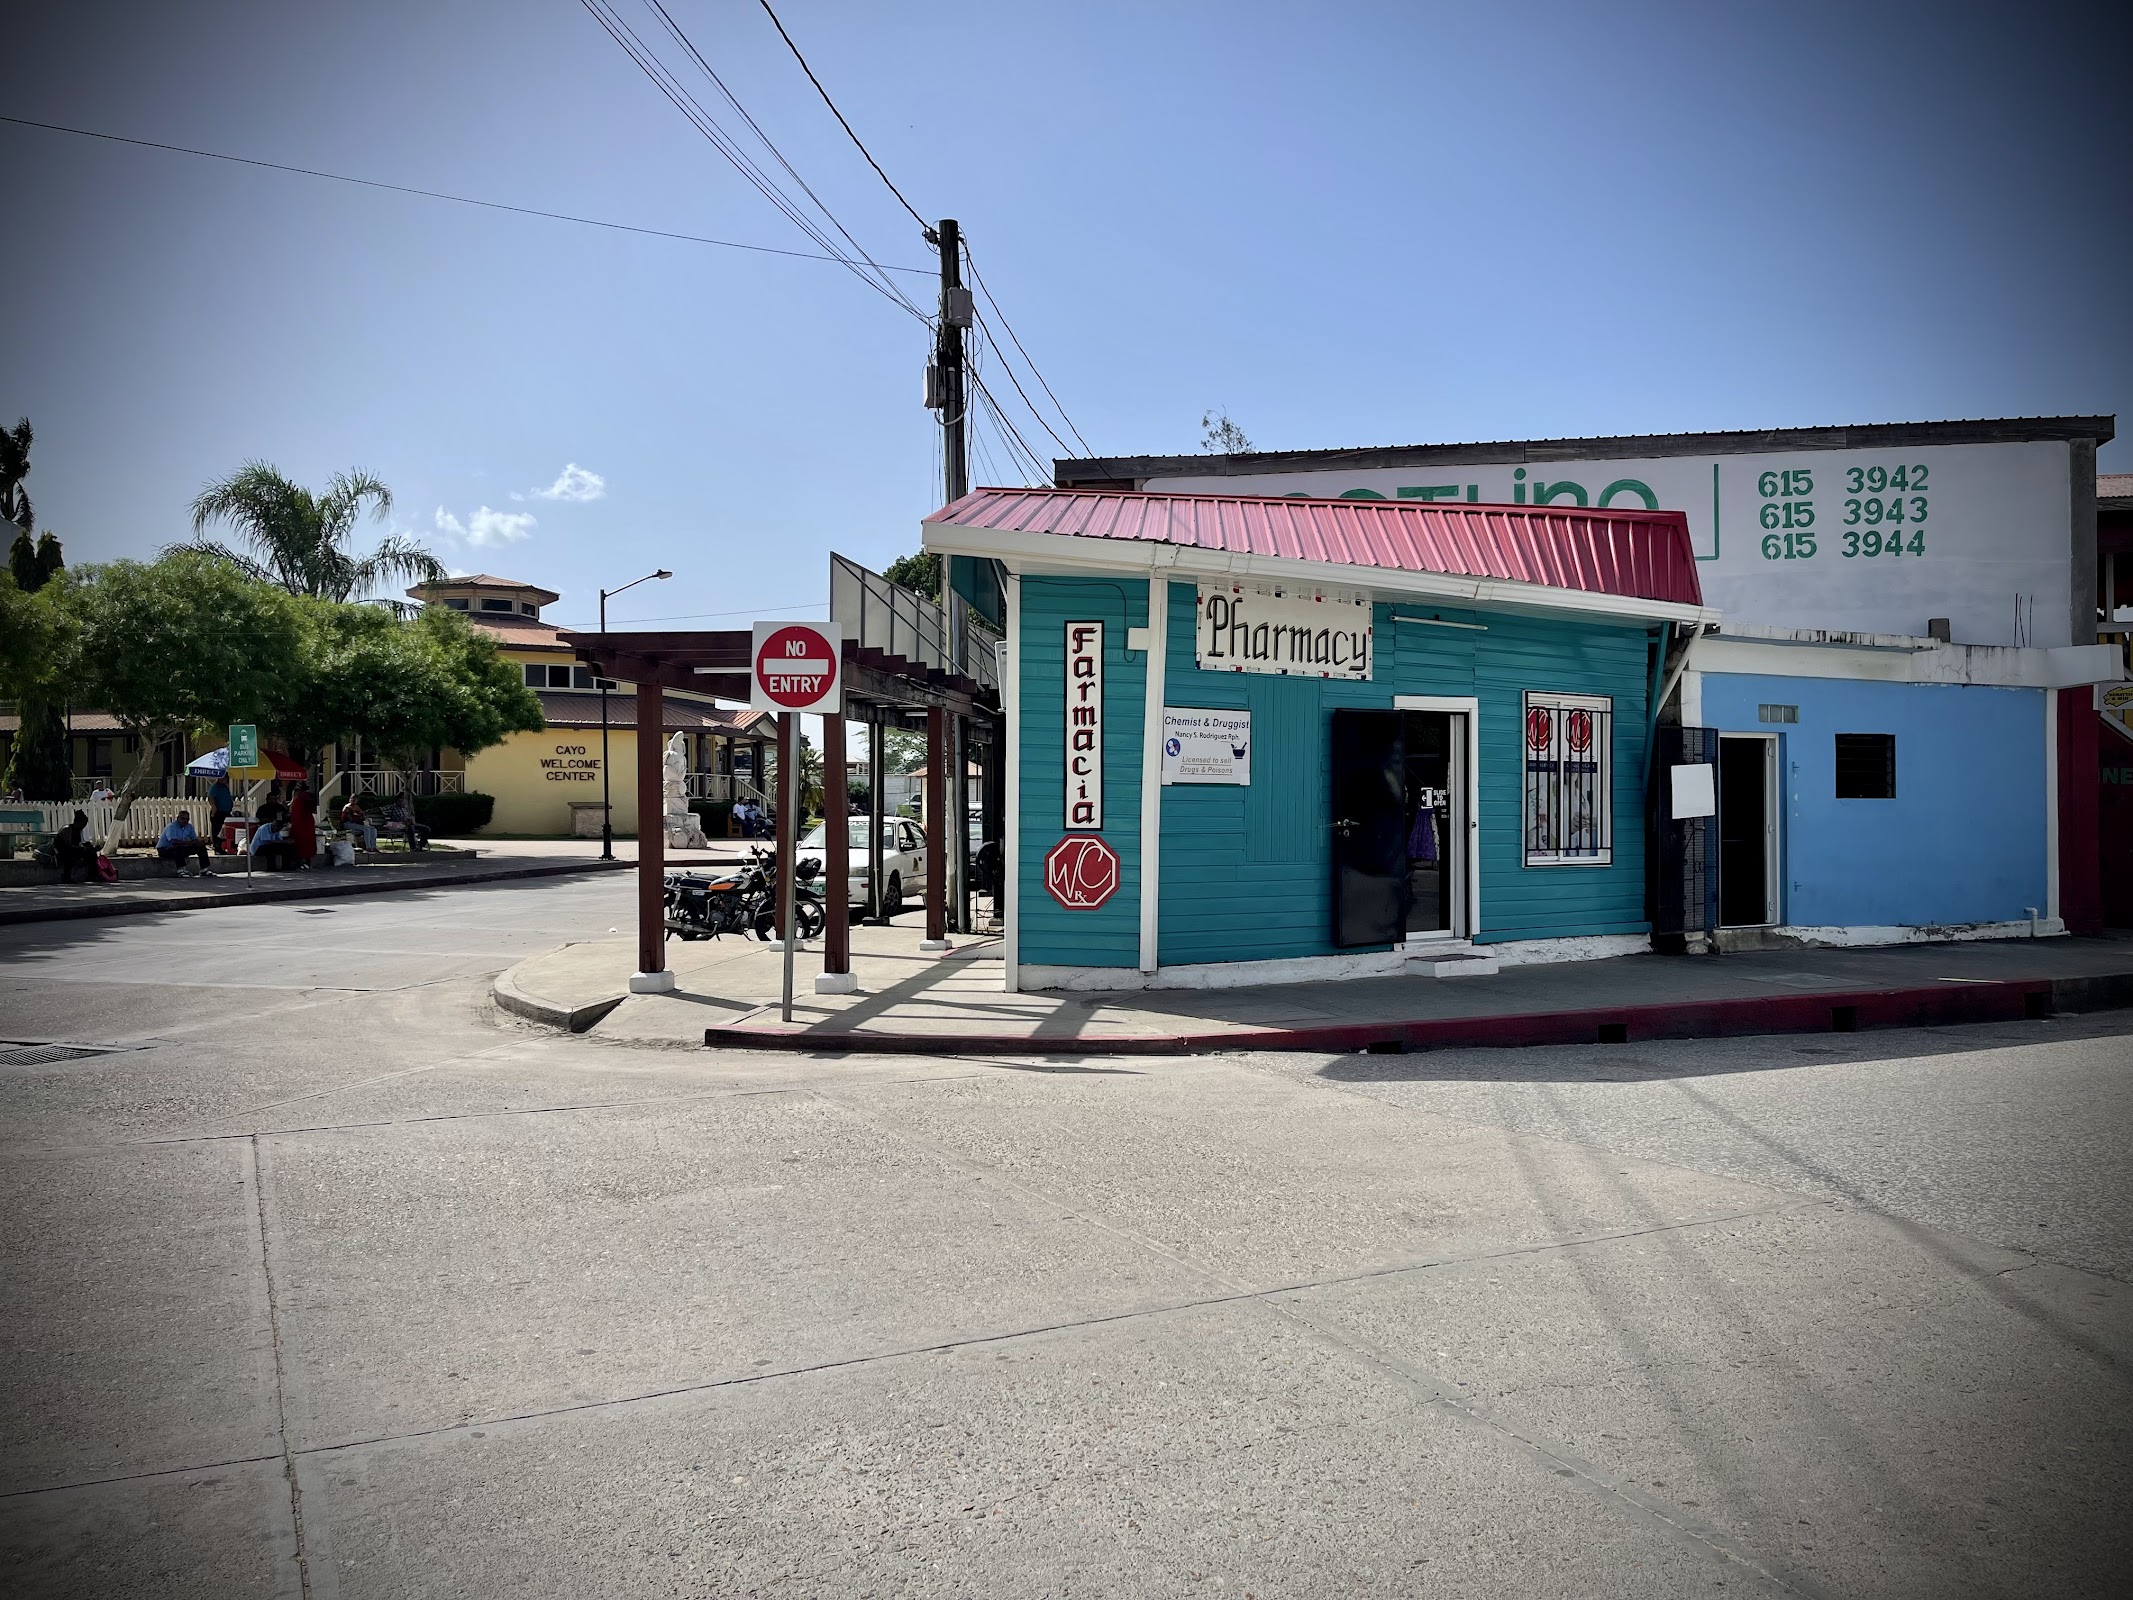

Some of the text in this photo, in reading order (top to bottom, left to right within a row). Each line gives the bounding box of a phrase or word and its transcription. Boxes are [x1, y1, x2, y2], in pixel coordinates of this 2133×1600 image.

[1757, 464, 1929, 498] 615 3942
[1759, 496, 1928, 530] 615 3943
[1761, 529, 1926, 560] 615 3944
[1206, 594, 1367, 671] Pharmacy
[785, 640, 807, 657] NO
[769, 676, 822, 693] ENTRY
[1072, 627, 1098, 824] Farmacia
[1164, 716, 1249, 730] Chemist & Druggist
[1175, 731, 1193, 740] Nancy
[1200, 732, 1227, 741] Rodriguez
[556, 745, 586, 755] CAYO
[540, 758, 602, 769] WELCOME
[1182, 756, 1211, 764] Licensed
[194, 768, 221, 776] DIRECT
[546, 771, 596, 781] CENTER
[1180, 766, 1199, 775] Drugs
